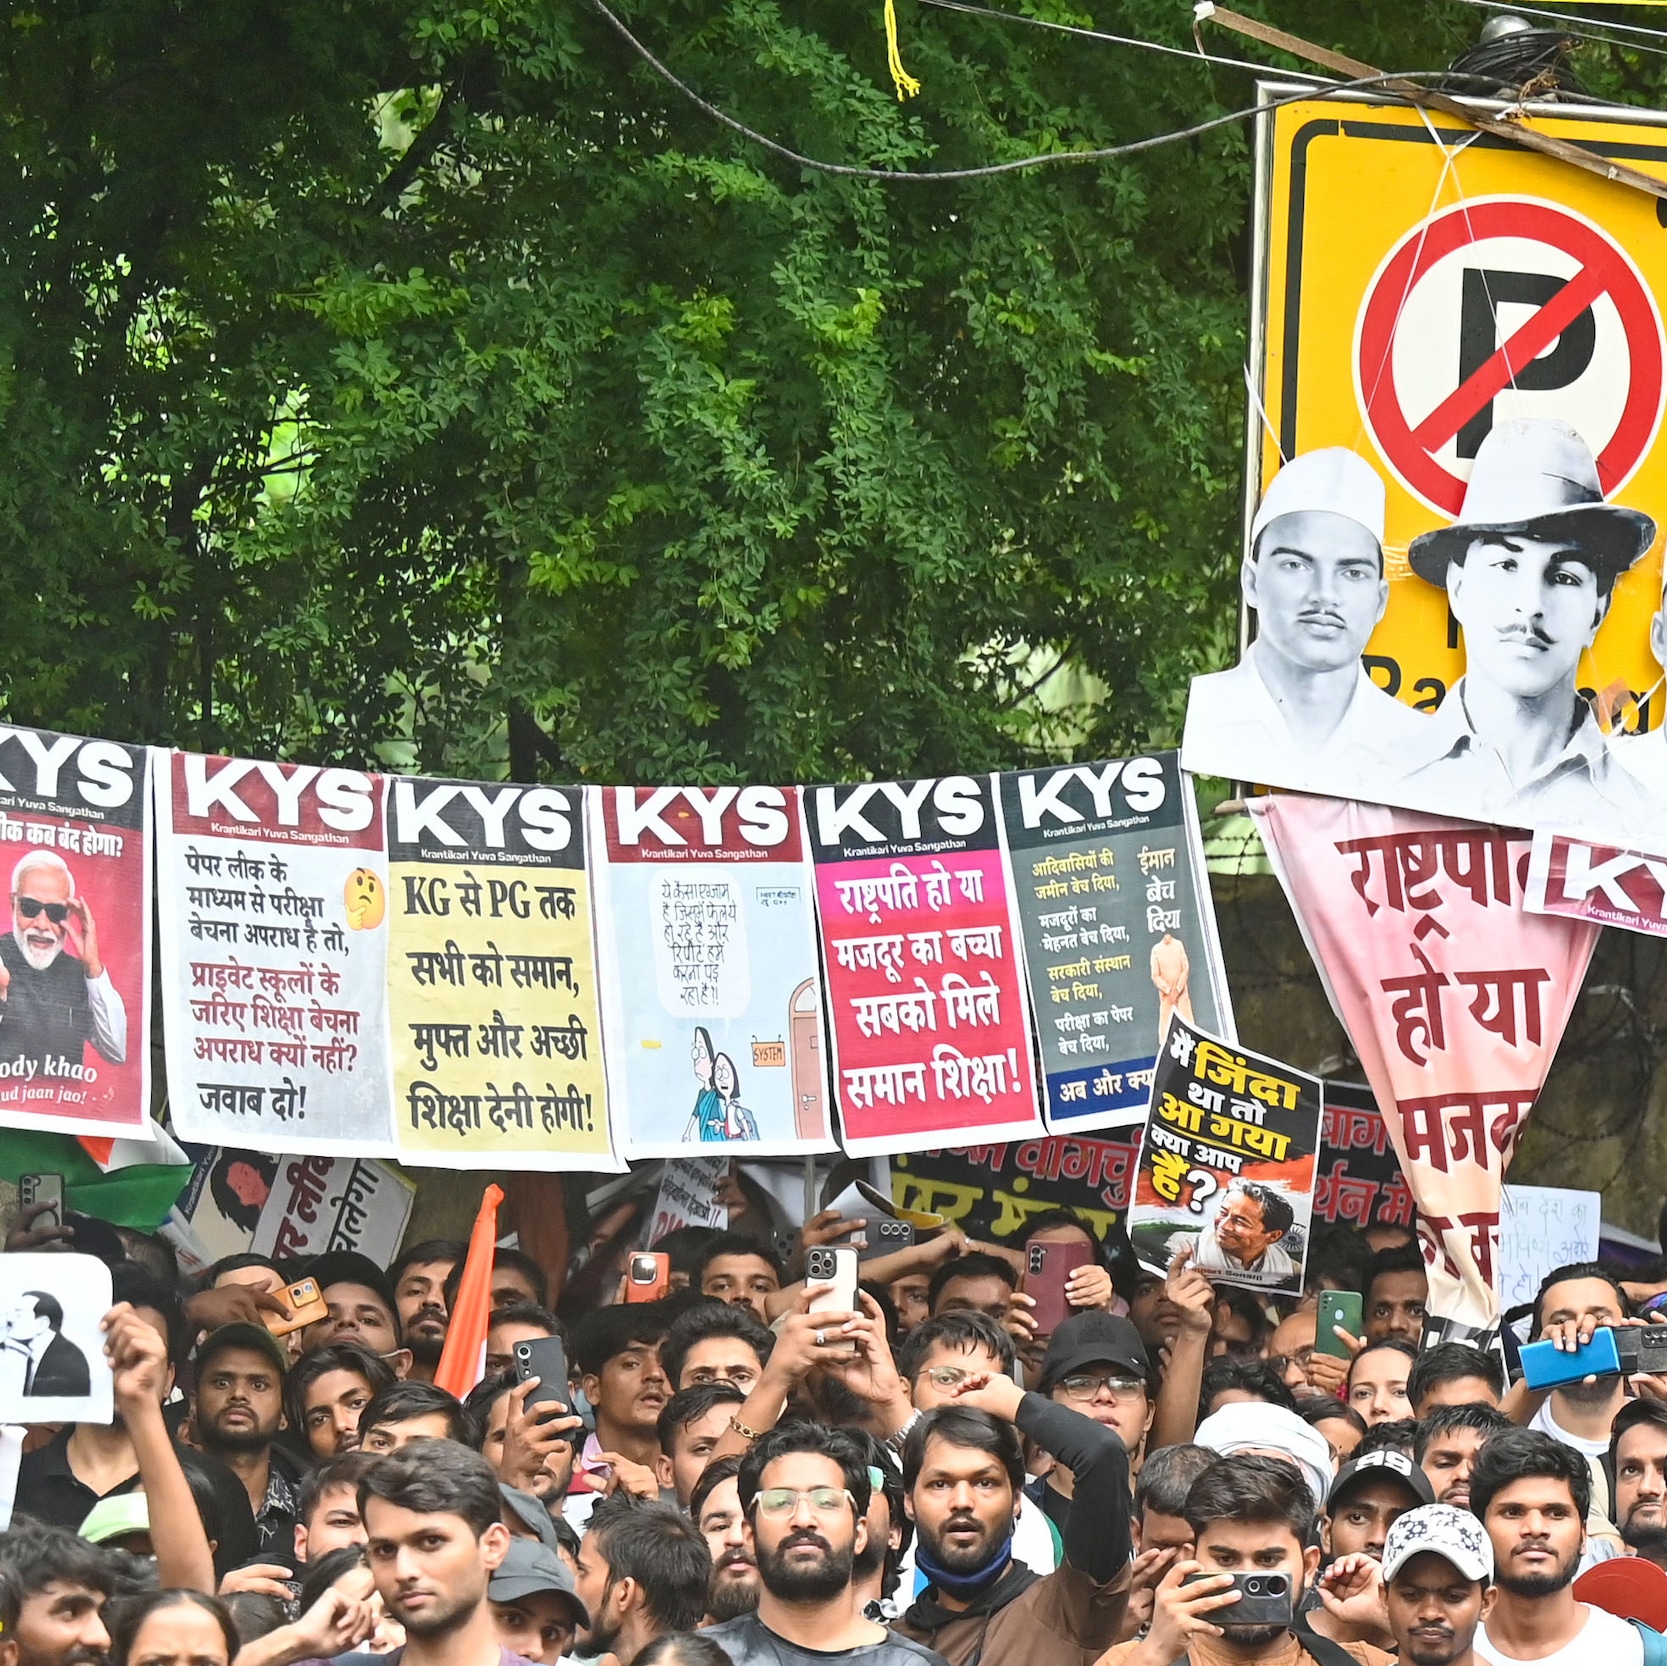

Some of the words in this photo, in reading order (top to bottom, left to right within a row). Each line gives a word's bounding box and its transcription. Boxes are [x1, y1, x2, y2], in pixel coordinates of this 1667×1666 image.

[18, 797, 46, 811] Yuva
[47, 801, 105, 820] Sangathan
[184, 754, 374, 832] KYS
[615, 784, 789, 846] KYS
[815, 775, 985, 846] KYS
[1018, 756, 1166, 829] KYS
[211, 822, 261, 837] Krantikari
[263, 828, 289, 840] Yuva
[290, 830, 350, 844] Sangathan
[395, 781, 572, 851] KYS
[83, 825, 123, 858] होगा?
[185, 845, 222, 877] पेपर
[225, 850, 266, 882] लीक
[269, 853, 289, 883] के
[421, 848, 470, 861] Krantikari
[471, 850, 496, 862] Yuva
[498, 851, 552, 864] Sangathan
[1099, 847, 1115, 867] की
[1138, 846, 1176, 876] ईमान
[186, 887, 247, 912] माध्यम
[250, 884, 265, 914] से
[269, 887, 325, 919] परीक्षा
[401, 876, 450, 916] KG
[454, 870, 483, 917] से
[487, 880, 531, 919] PG
[534, 886, 576, 921] तक
[834, 862, 919, 924] राष्ट्रपति
[921, 860, 952, 912] हो
[955, 869, 985, 904] या
[1146, 875, 1176, 903] बेच
[188, 911, 240, 943] बेचना
[244, 922, 300, 949] अपराध
[303, 918, 318, 953] है
[321, 922, 350, 956] तो,
[1146, 906, 1182, 934] दिया
[1587, 904, 1640, 926] Krantikari
[405, 939, 466, 987] सभी
[468, 940, 504, 988] को
[505, 955, 580, 998] समान,
[831, 933, 905, 983] मजदूर
[907, 931, 943, 966] का
[946, 925, 1003, 962] बच्चा
[189, 955, 254, 993] प्राइवेट
[257, 961, 315, 1003] स्कूलों
[318, 963, 341, 996] के
[190, 993, 248, 1032] जरिए
[251, 994, 305, 1036] शिक्षा
[307, 999, 360, 1035] बेचना
[850, 976, 937, 1038] सबको
[939, 970, 1001, 1029] मिले
[1381, 943, 1451, 1067] हो
[1454, 967, 1552, 1048] या
[193, 1036, 265, 1065] अपराध
[267, 1034, 307, 1068] क्यों
[310, 1036, 358, 1074] नहीं?
[408, 1023, 472, 1072] मुफ्त
[477, 1009, 524, 1059] और
[530, 1013, 588, 1061] अच्छी
[753, 1046, 784, 1063] SYSTEM
[44, 1054, 97, 1084] khao
[842, 1062, 927, 1109] समान
[930, 1043, 1022, 1105] शिक्षा!
[1059, 1080, 1087, 1102] अब
[1093, 1068, 1123, 1096] और
[1170, 1028, 1197, 1068] मैं
[1195, 1041, 1301, 1110] जिंदा
[22, 1086, 54, 1104] jaan
[196, 1082, 265, 1116] जवाब
[269, 1076, 307, 1121] दो!
[406, 1080, 482, 1137] शिक्षा
[484, 1081, 534, 1133] देनी
[536, 1082, 594, 1134] होगी!
[1187, 1082, 1227, 1113] था
[1230, 1097, 1266, 1125] तो
[1150, 1123, 1191, 1156] क्या
[1194, 1143, 1243, 1174] आप
[1158, 1092, 1205, 1133] आ
[1210, 1112, 1291, 1161] गया
[1355, 1449, 1413, 1477] 99
